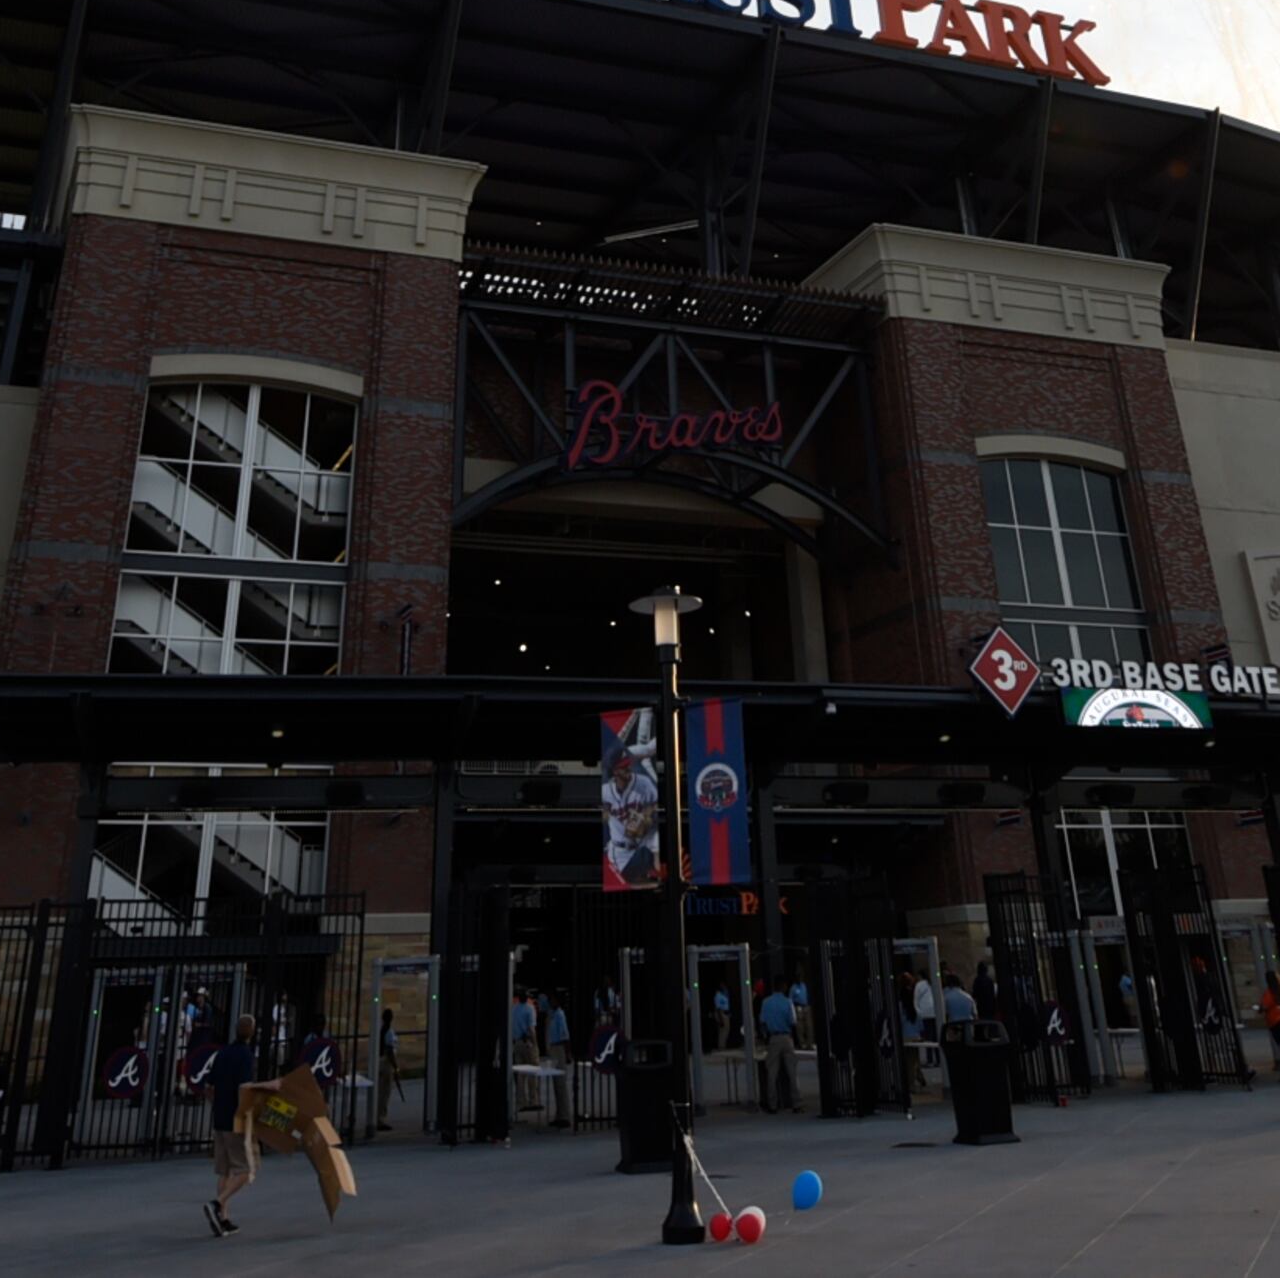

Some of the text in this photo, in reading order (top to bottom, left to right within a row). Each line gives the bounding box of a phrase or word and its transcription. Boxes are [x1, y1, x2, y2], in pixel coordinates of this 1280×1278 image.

[567, 379, 782, 471] Braves
[1050, 657, 1113, 689] 3RD
[1119, 660, 1204, 692] BASE
